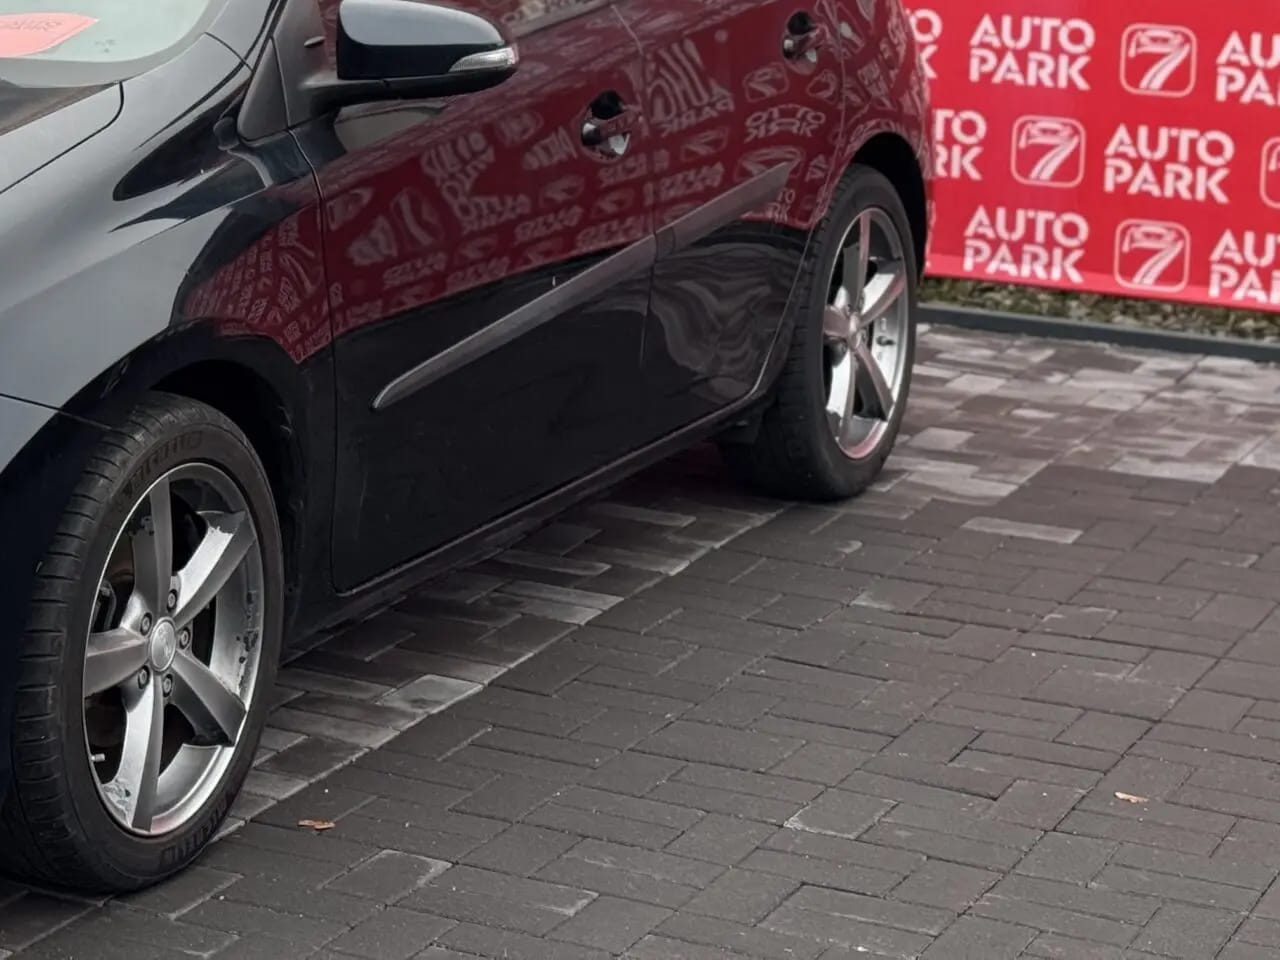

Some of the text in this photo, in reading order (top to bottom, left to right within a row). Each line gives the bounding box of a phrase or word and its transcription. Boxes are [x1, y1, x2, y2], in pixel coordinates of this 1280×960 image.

[970, 14, 1095, 54] AUTO
[969, 48, 1090, 90] PARK
[1105, 124, 1234, 167] AUTO
[1104, 159, 1229, 203] PARK
[965, 206, 1089, 246] AUTO
[964, 240, 1083, 282] PARK
